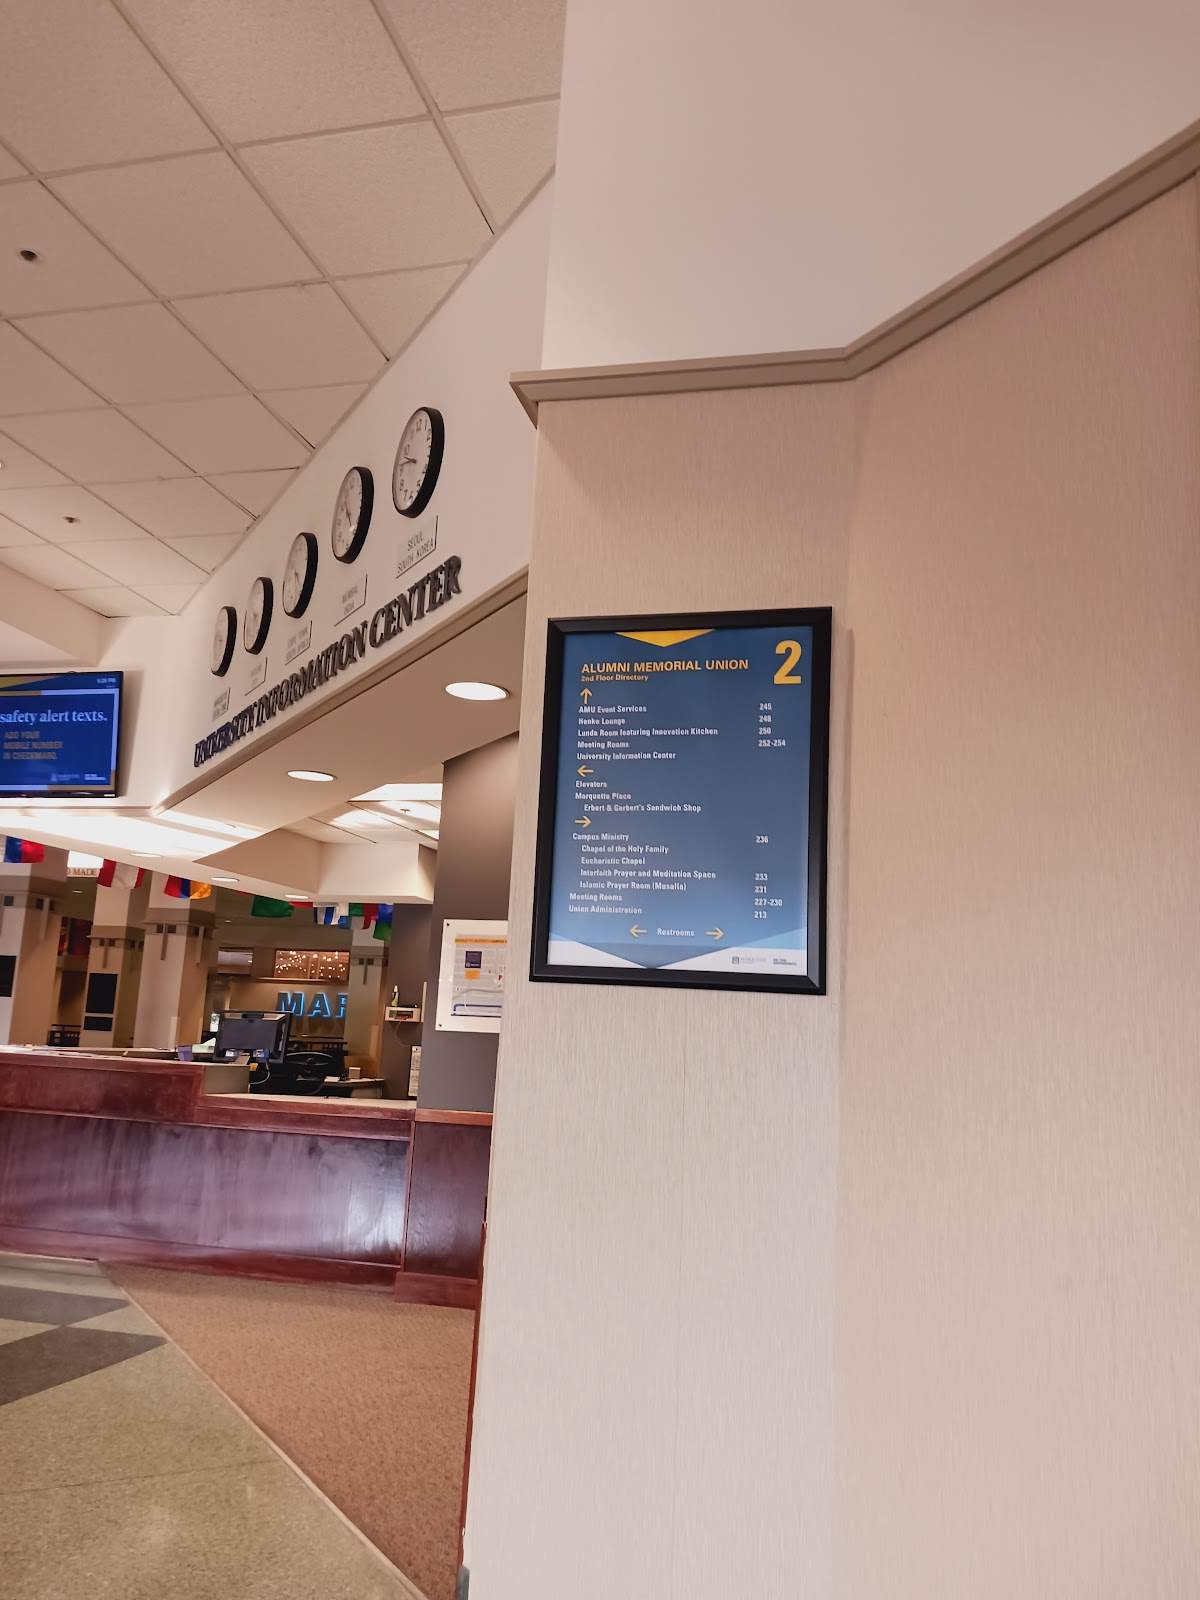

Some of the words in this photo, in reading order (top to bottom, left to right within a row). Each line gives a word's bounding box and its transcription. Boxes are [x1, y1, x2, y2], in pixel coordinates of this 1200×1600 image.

[408, 531, 423, 551] SEOUL
[397, 552, 414, 574] SOUTH
[416, 538, 433, 558] KOREA
[193, 701, 258, 768] UNIVERSITY
[254, 620, 368, 728] INFORMATION
[369, 556, 462, 649] CENTER
[582, 662, 630, 673] ALUMNI
[634, 660, 702, 672] MEMORIAL
[705, 659, 749, 670] UNION
[774, 640, 802, 684] 2
[616, 674, 648, 682] Directory
[617, 705, 646, 713] Services
[759, 702, 772, 710] 245
[0, 710, 37, 726] safety
[40, 709, 69, 722] alert
[72, 711, 107, 722] texts.
[602, 718, 625, 726] Lounge
[620, 728, 651, 737] featuring
[578, 741, 606, 749] Meeting
[577, 752, 611, 760] University
[683, 804, 701, 813] Shop
[572, 833, 599, 841] Campus
[601, 833, 629, 841] Ministry
[582, 845, 606, 853] Chapel
[628, 845, 644, 853] Holy
[645, 845, 669, 854] Family
[622, 857, 645, 866] Chapel
[614, 869, 636, 878] Prayer
[693, 870, 716, 880] Space
[607, 882, 629, 890] Prayer
[652, 882, 687, 891] (Musalla)
[570, 893, 598, 902] Meeting
[754, 898, 783, 906] 227-230
[590, 906, 642, 914] Administration
[754, 910, 767, 918] 213
[657, 928, 695, 937] Restrooms
